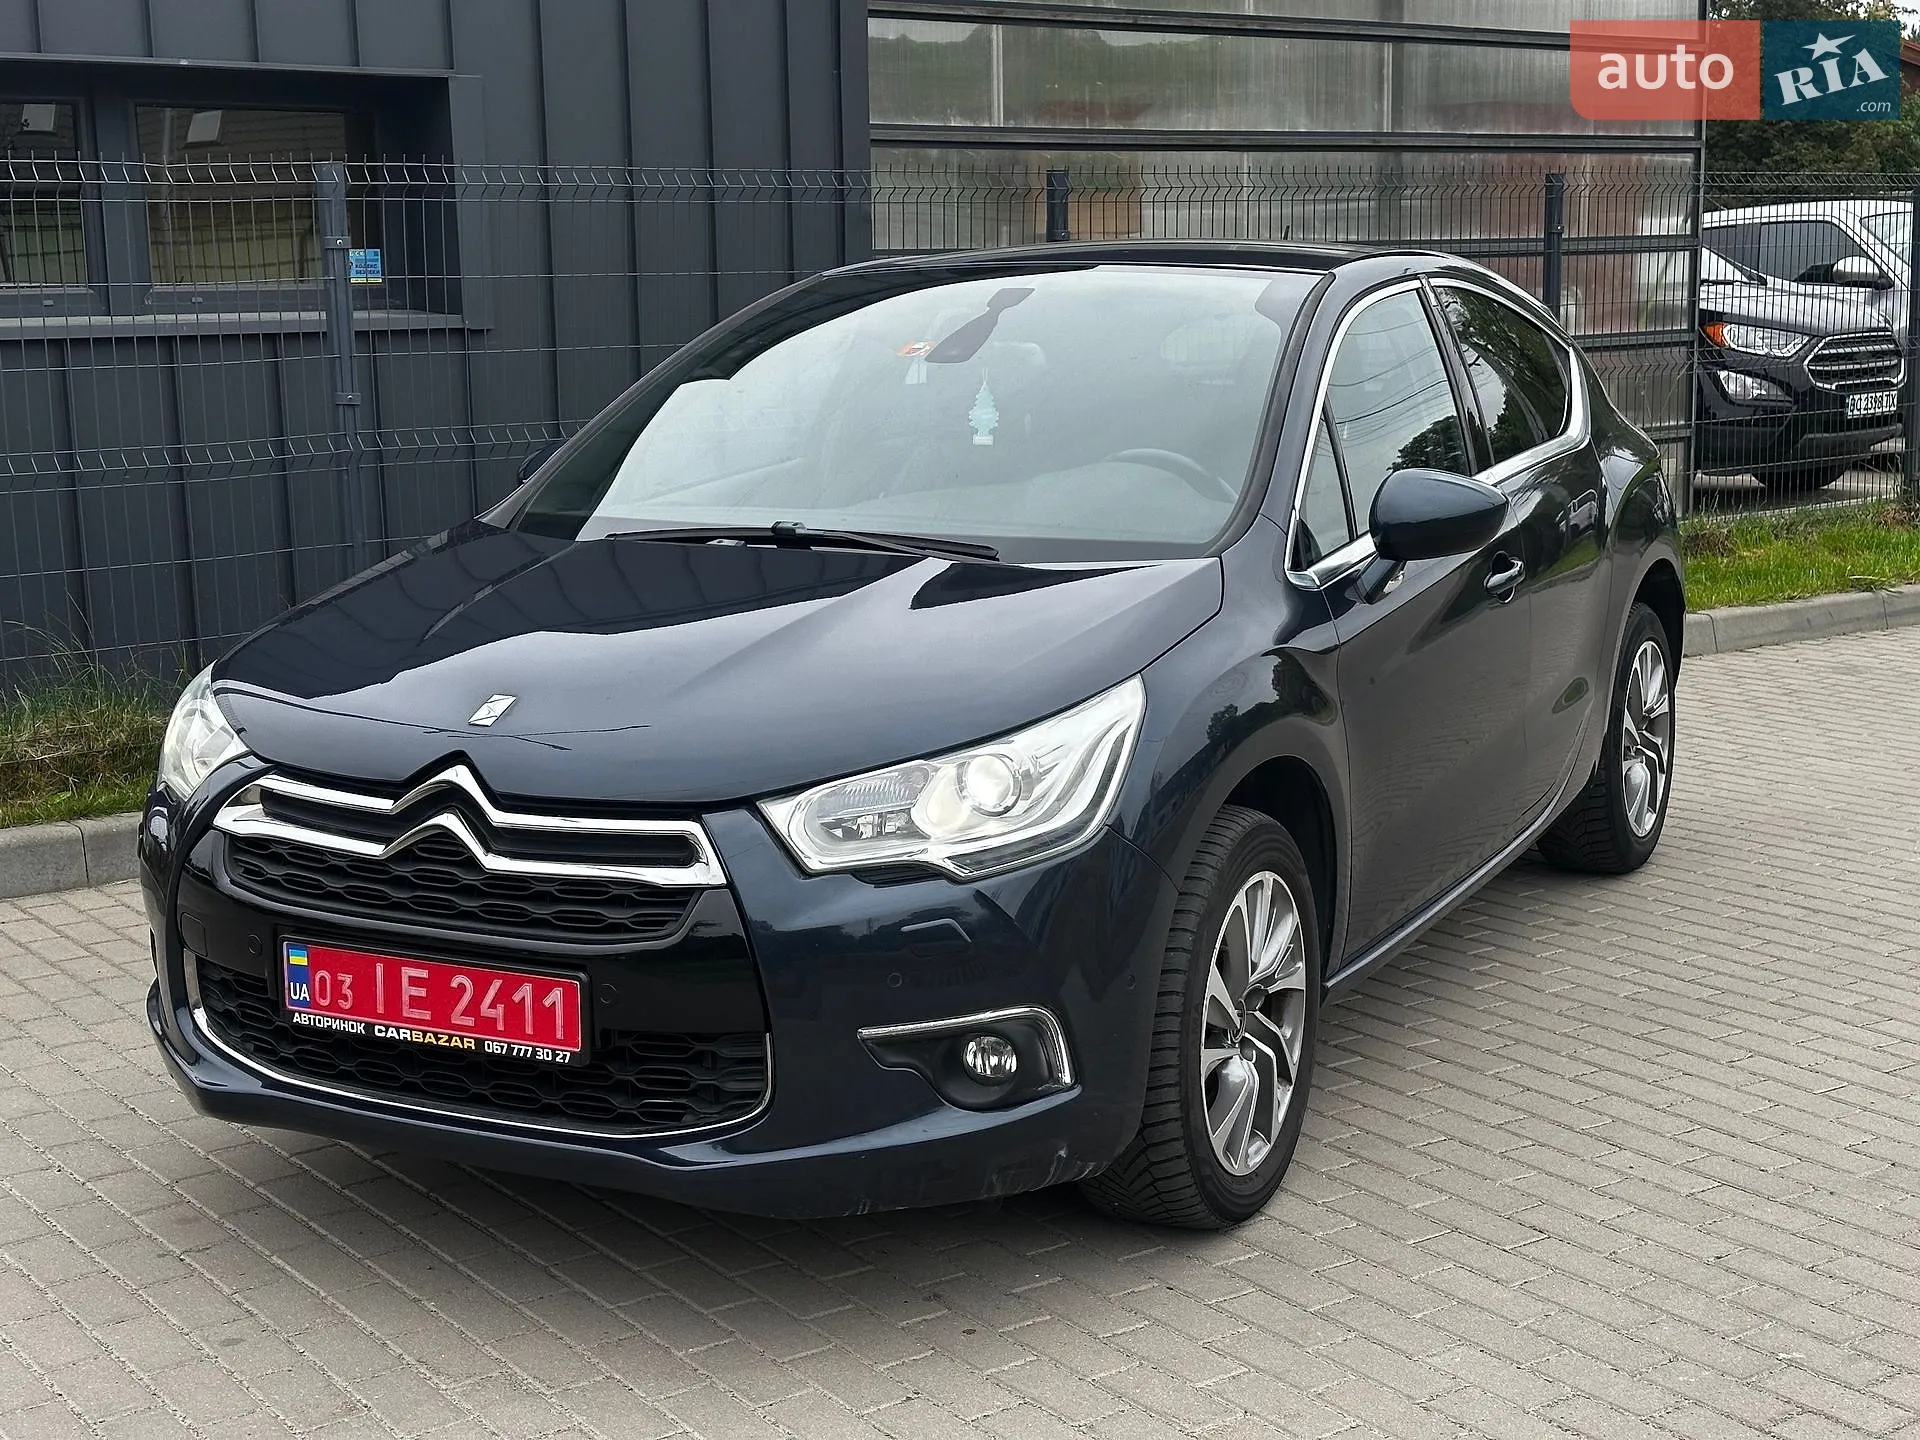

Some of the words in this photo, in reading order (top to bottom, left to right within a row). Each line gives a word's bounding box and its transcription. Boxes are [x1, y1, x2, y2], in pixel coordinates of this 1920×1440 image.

[290, 981, 310, 1002] UA
[314, 970, 353, 1010] 03
[375, 962, 432, 1021] IE
[450, 974, 564, 1040] 2411
[292, 1012, 366, 1035] АВТОРИНОК
[373, 1025, 476, 1051] CARBAZAR
[484, 1041, 508, 1054] 067
[510, 1044, 533, 1057] 777
[535, 1047, 553, 1061] 30
[555, 1050, 571, 1064] 27
